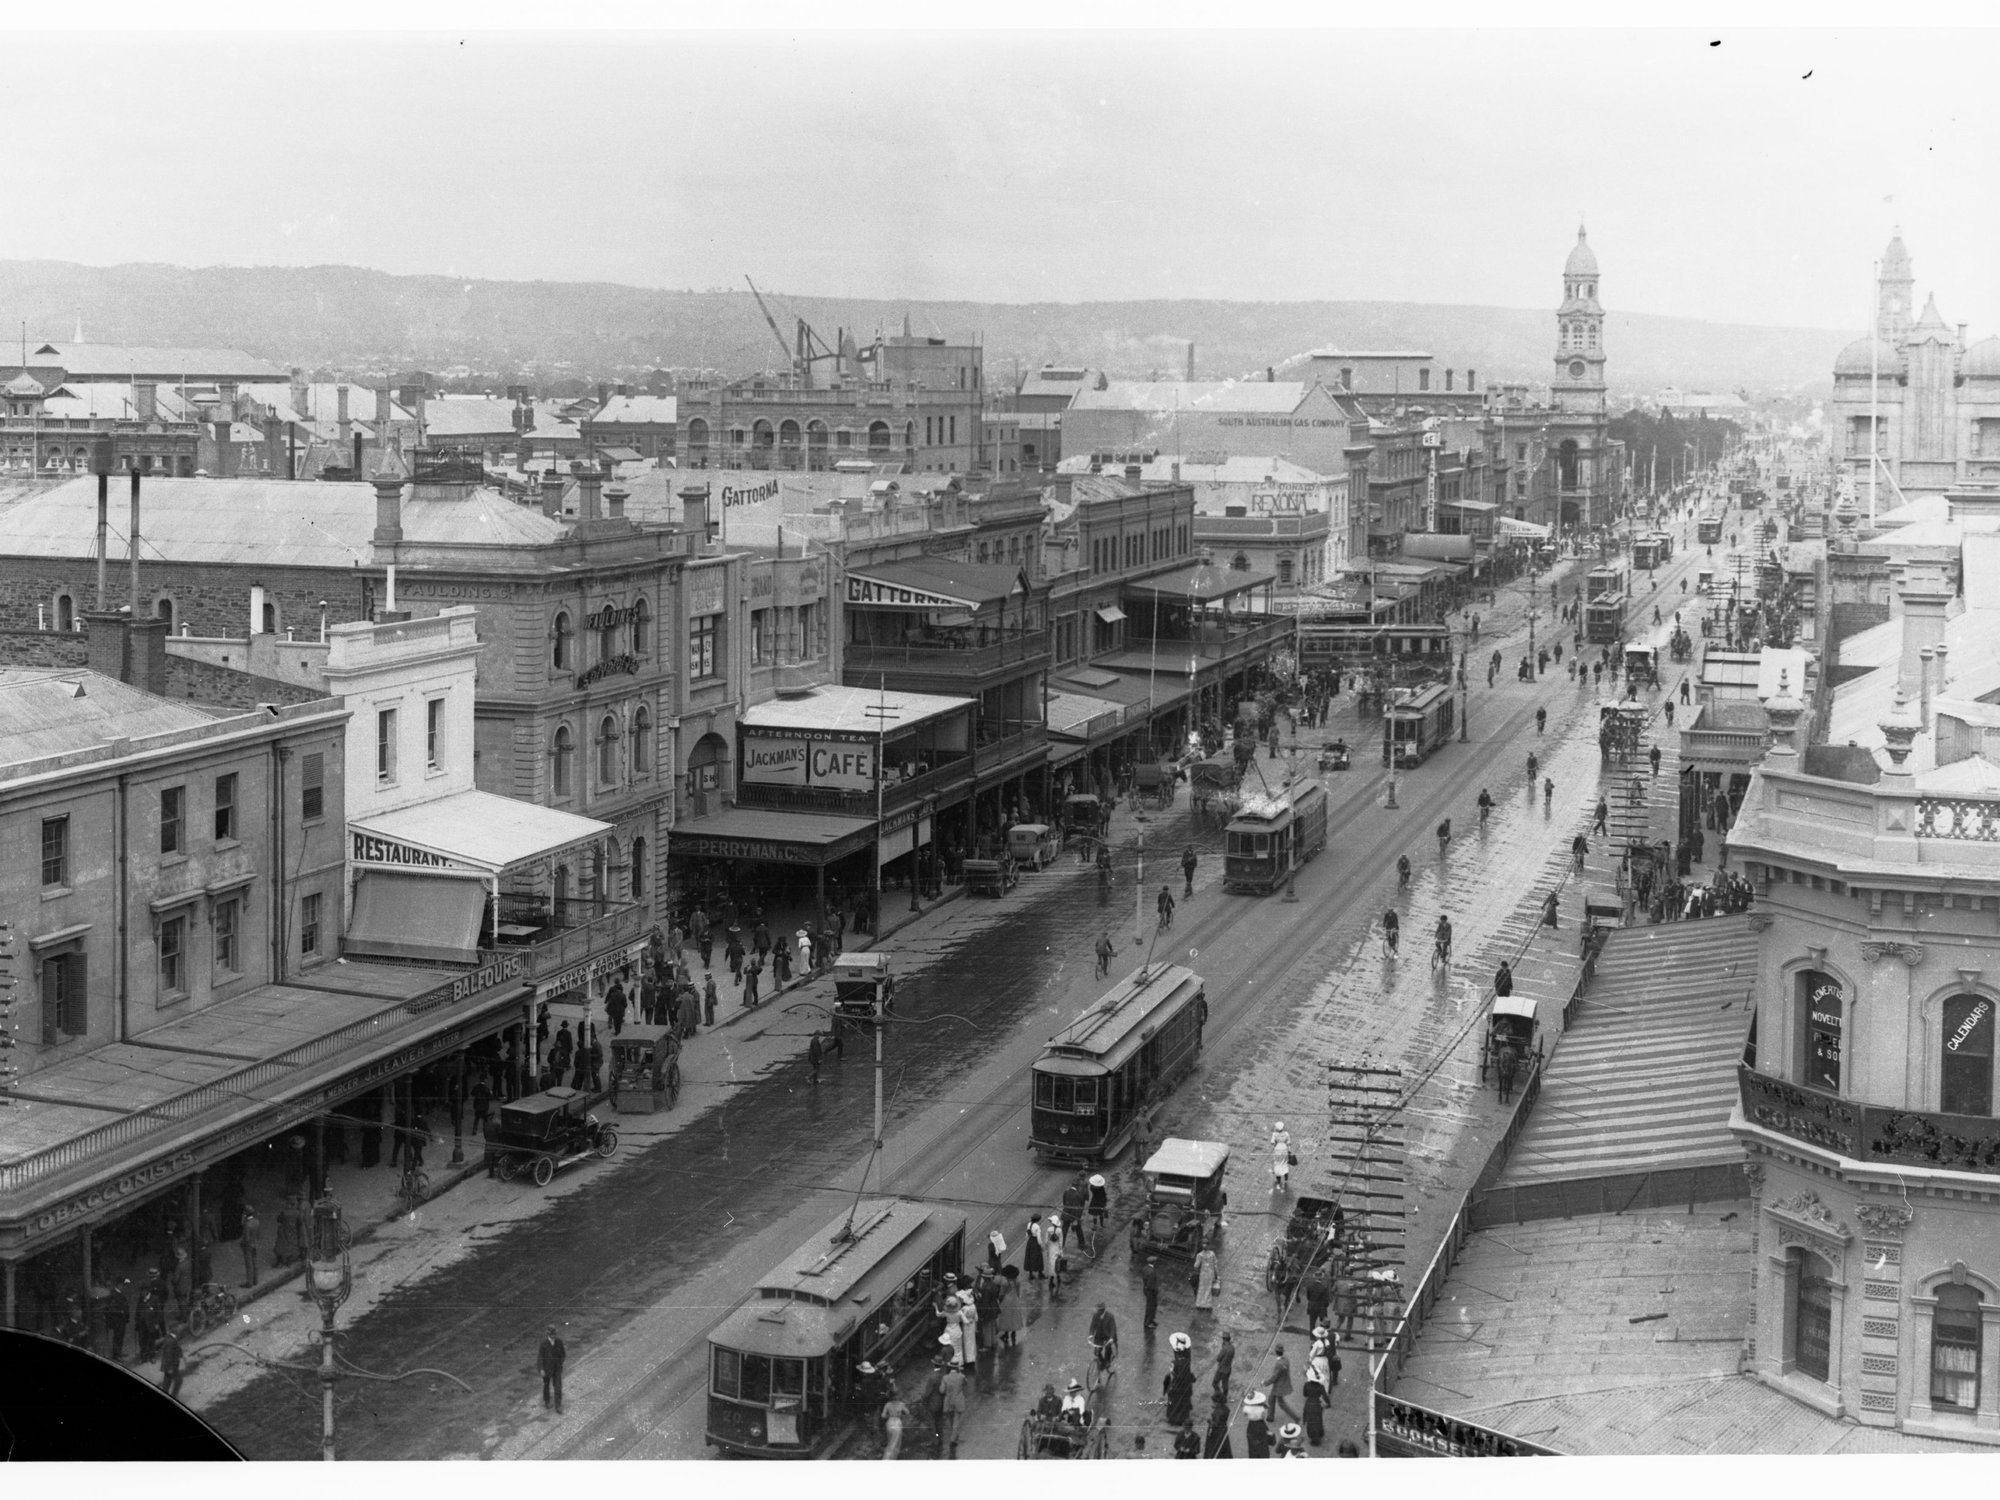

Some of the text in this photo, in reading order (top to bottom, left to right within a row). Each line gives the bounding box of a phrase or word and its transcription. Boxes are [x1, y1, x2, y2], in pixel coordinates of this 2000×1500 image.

[1218, 418, 1346, 428] SOUTH AUSTRALIAN GAS COMPANY
[722, 479, 779, 507] GATTORNA
[1252, 494, 1307, 512] REXONA
[401, 583, 491, 600] FAULDING
[850, 578, 953, 605] GATTORNA
[748, 729, 867, 743] AFTERNOON TEA
[746, 745, 805, 769] JACKMAN'S
[700, 839, 778, 859] PERRYMAN
[452, 956, 520, 1002] BALFOURS
[558, 950, 628, 984] COVENT GARDEN
[546, 974, 587, 999] DINING
[1946, 1001, 1990, 1051] CALENDARS
[1817, 1048, 1824, 1057] &
[327, 1078, 360, 1099] MERCER
[377, 1046, 425, 1076] LEAVER
[432, 1031, 461, 1050] HATTER
